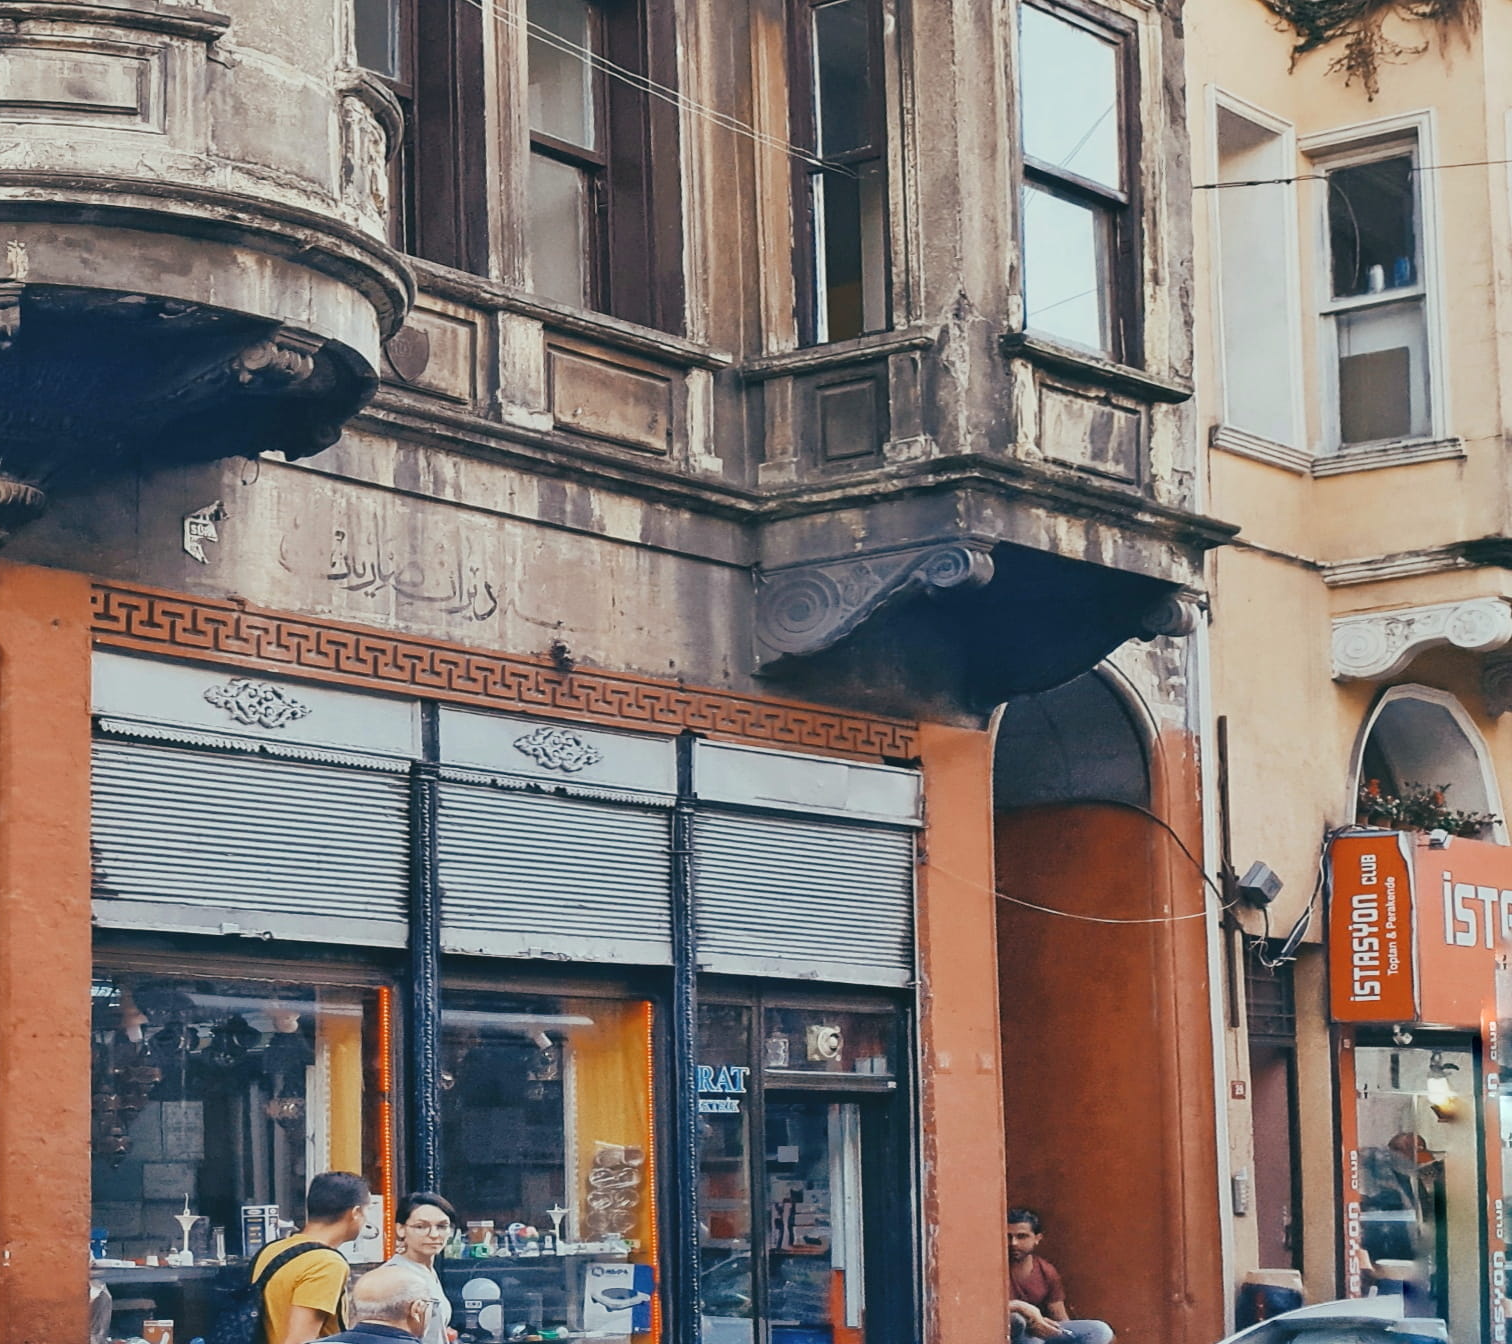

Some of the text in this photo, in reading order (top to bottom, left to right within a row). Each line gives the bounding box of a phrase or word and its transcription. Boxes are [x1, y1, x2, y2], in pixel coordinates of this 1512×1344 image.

[1360, 853, 1377, 886] CLUB
[1385, 930, 1397, 940] &
[1386, 941, 1399, 977] Toptan
[696, 1065, 750, 1093] RAT
